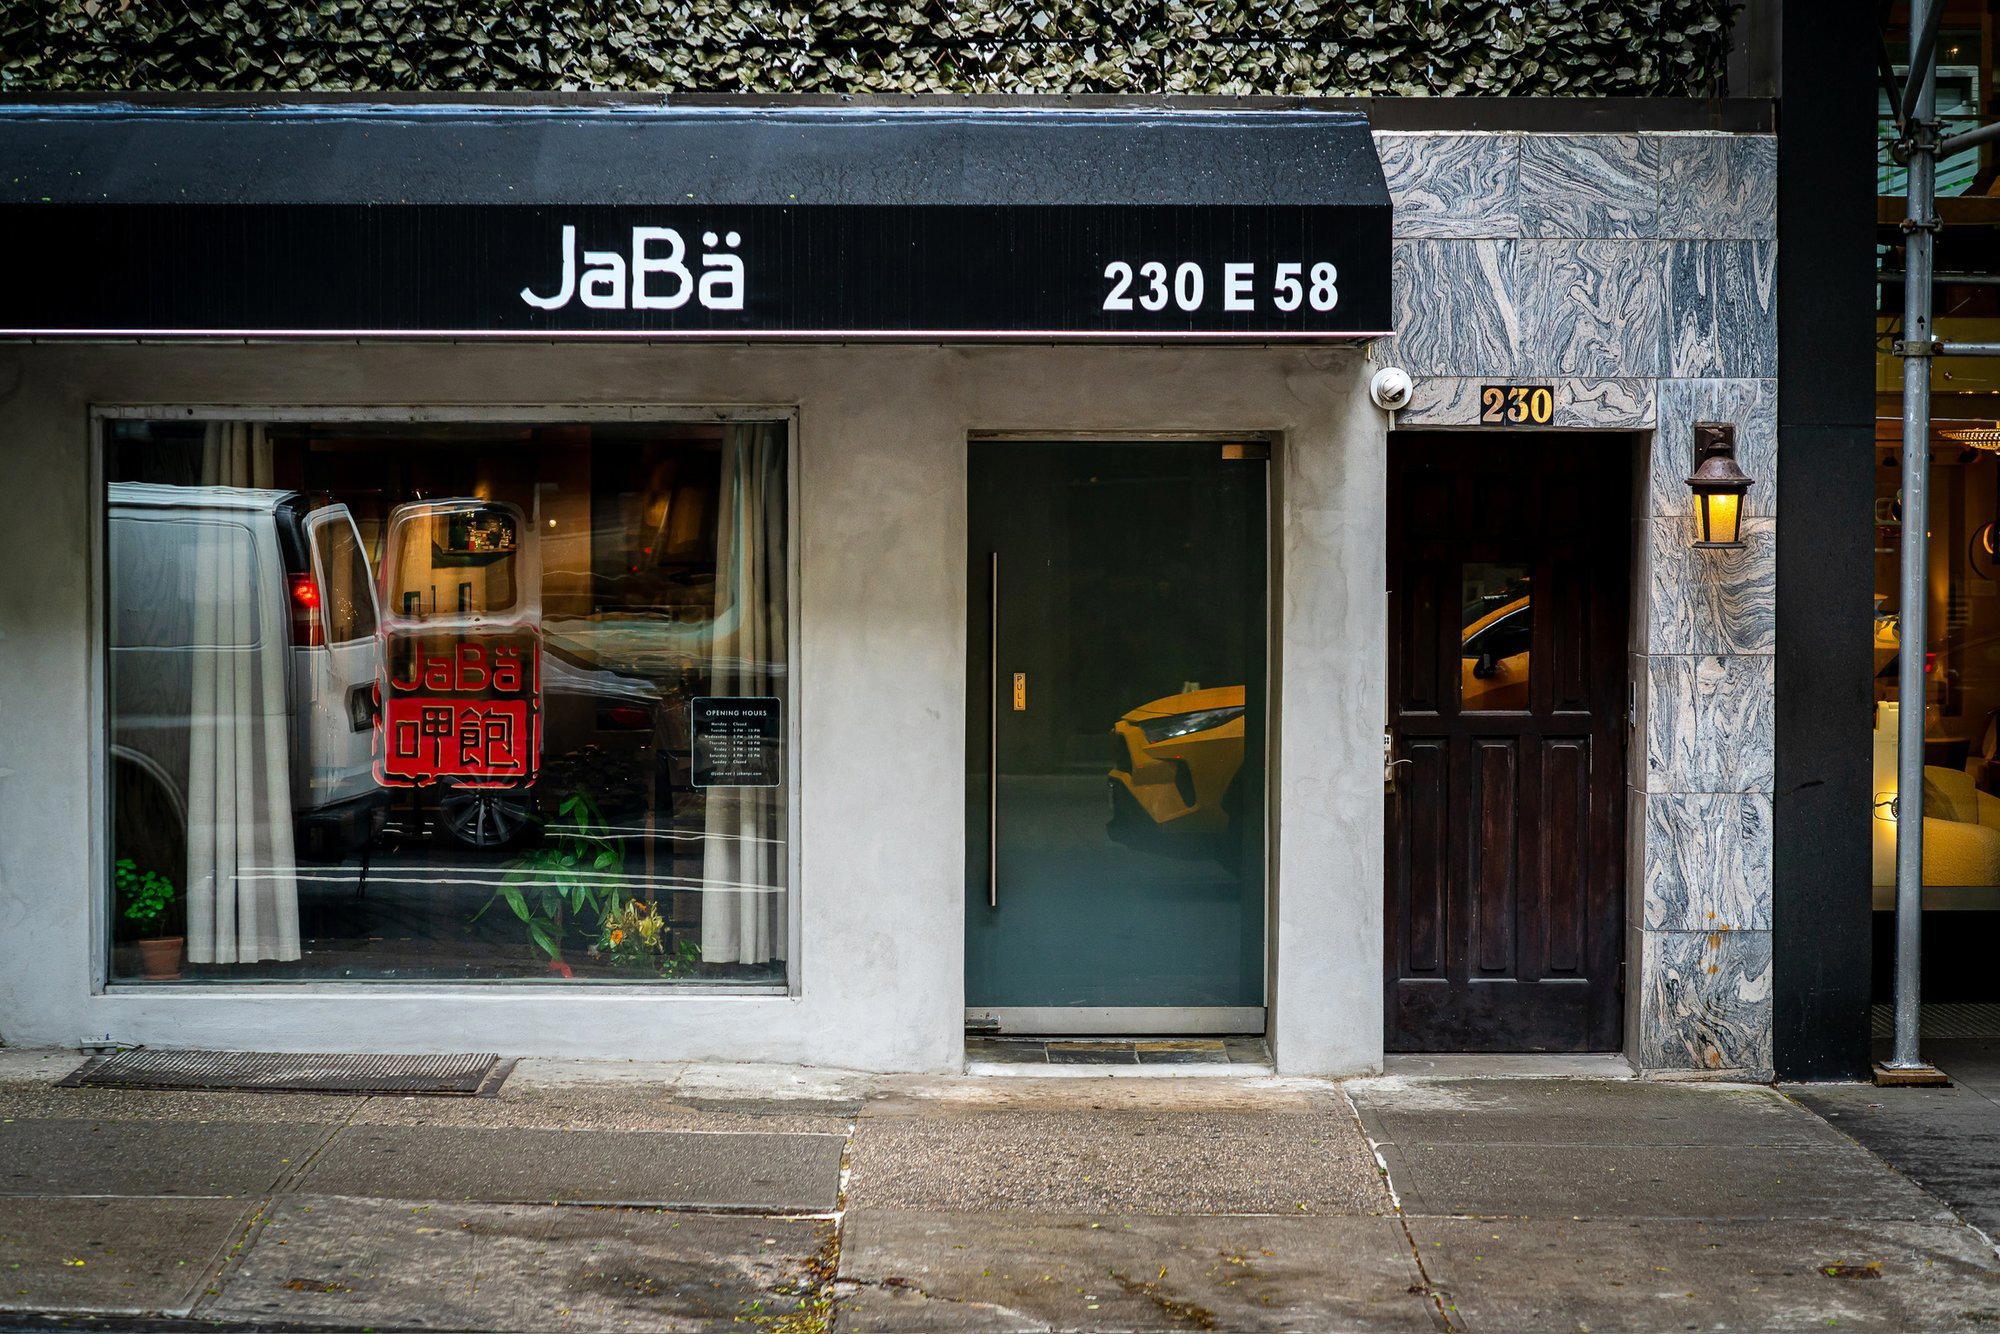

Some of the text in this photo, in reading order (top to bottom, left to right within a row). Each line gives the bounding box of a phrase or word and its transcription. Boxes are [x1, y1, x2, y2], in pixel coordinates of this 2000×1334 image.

[520, 225, 744, 310] JaBä
[1102, 261, 1339, 311] 230 E 58
[1481, 386, 1553, 424] 230
[391, 641, 522, 692] JaBä
[395, 706, 520, 768] 呷飽
